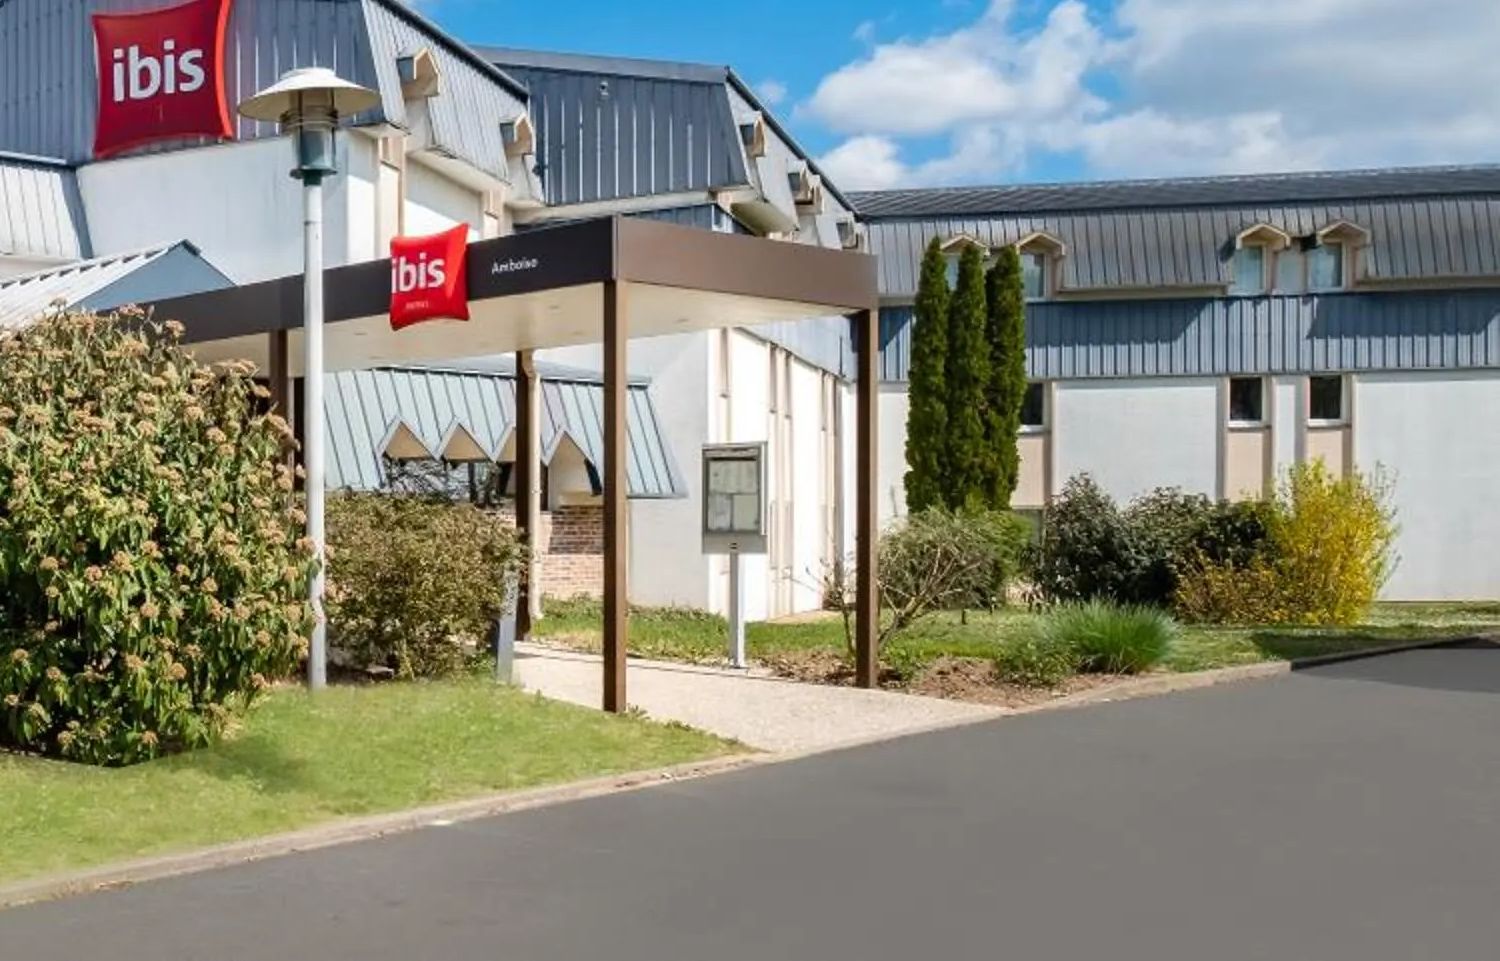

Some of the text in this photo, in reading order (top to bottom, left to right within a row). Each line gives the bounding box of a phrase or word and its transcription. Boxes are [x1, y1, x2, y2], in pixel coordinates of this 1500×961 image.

[112, 39, 205, 102] ibis
[391, 252, 445, 293] ibis
[491, 256, 538, 274] Amboise
